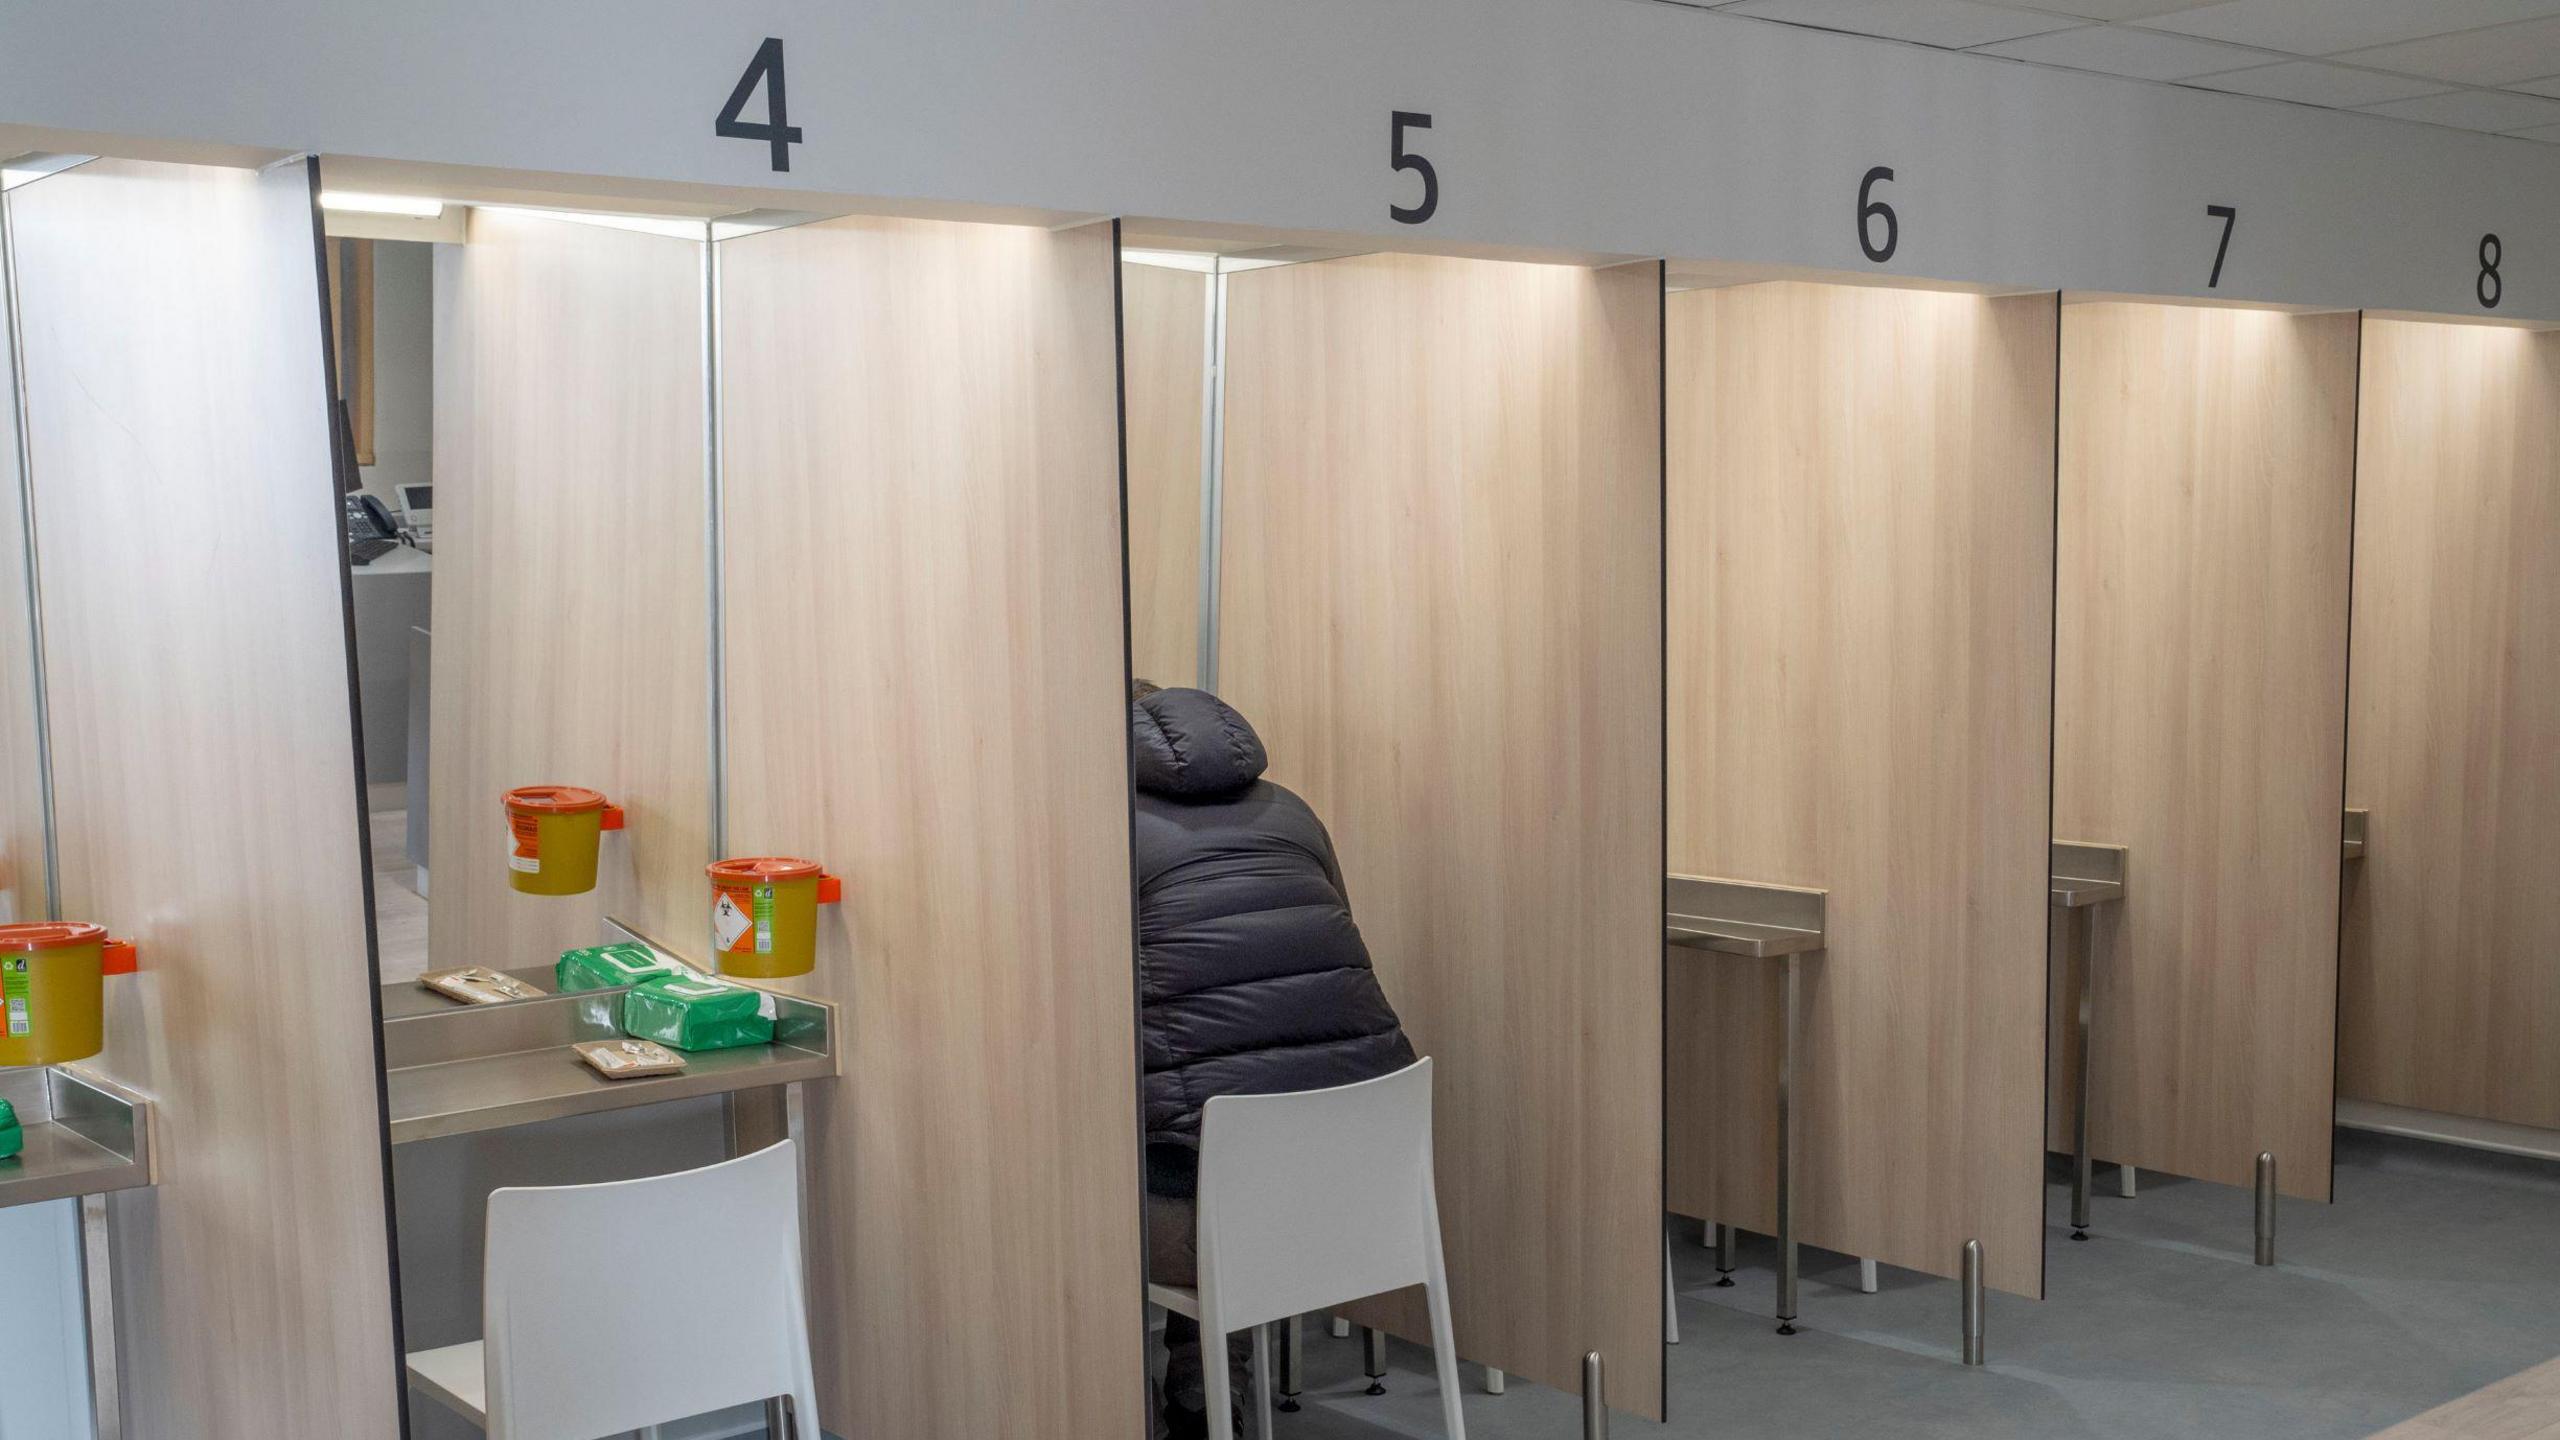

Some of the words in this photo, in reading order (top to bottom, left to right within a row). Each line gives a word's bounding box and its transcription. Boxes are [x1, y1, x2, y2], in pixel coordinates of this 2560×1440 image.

[716, 37, 803, 172] 4
[1389, 111, 1439, 224] 5
[1856, 166, 1899, 263] 6
[2207, 204, 2237, 288] 7
[2477, 233, 2502, 309] 8
